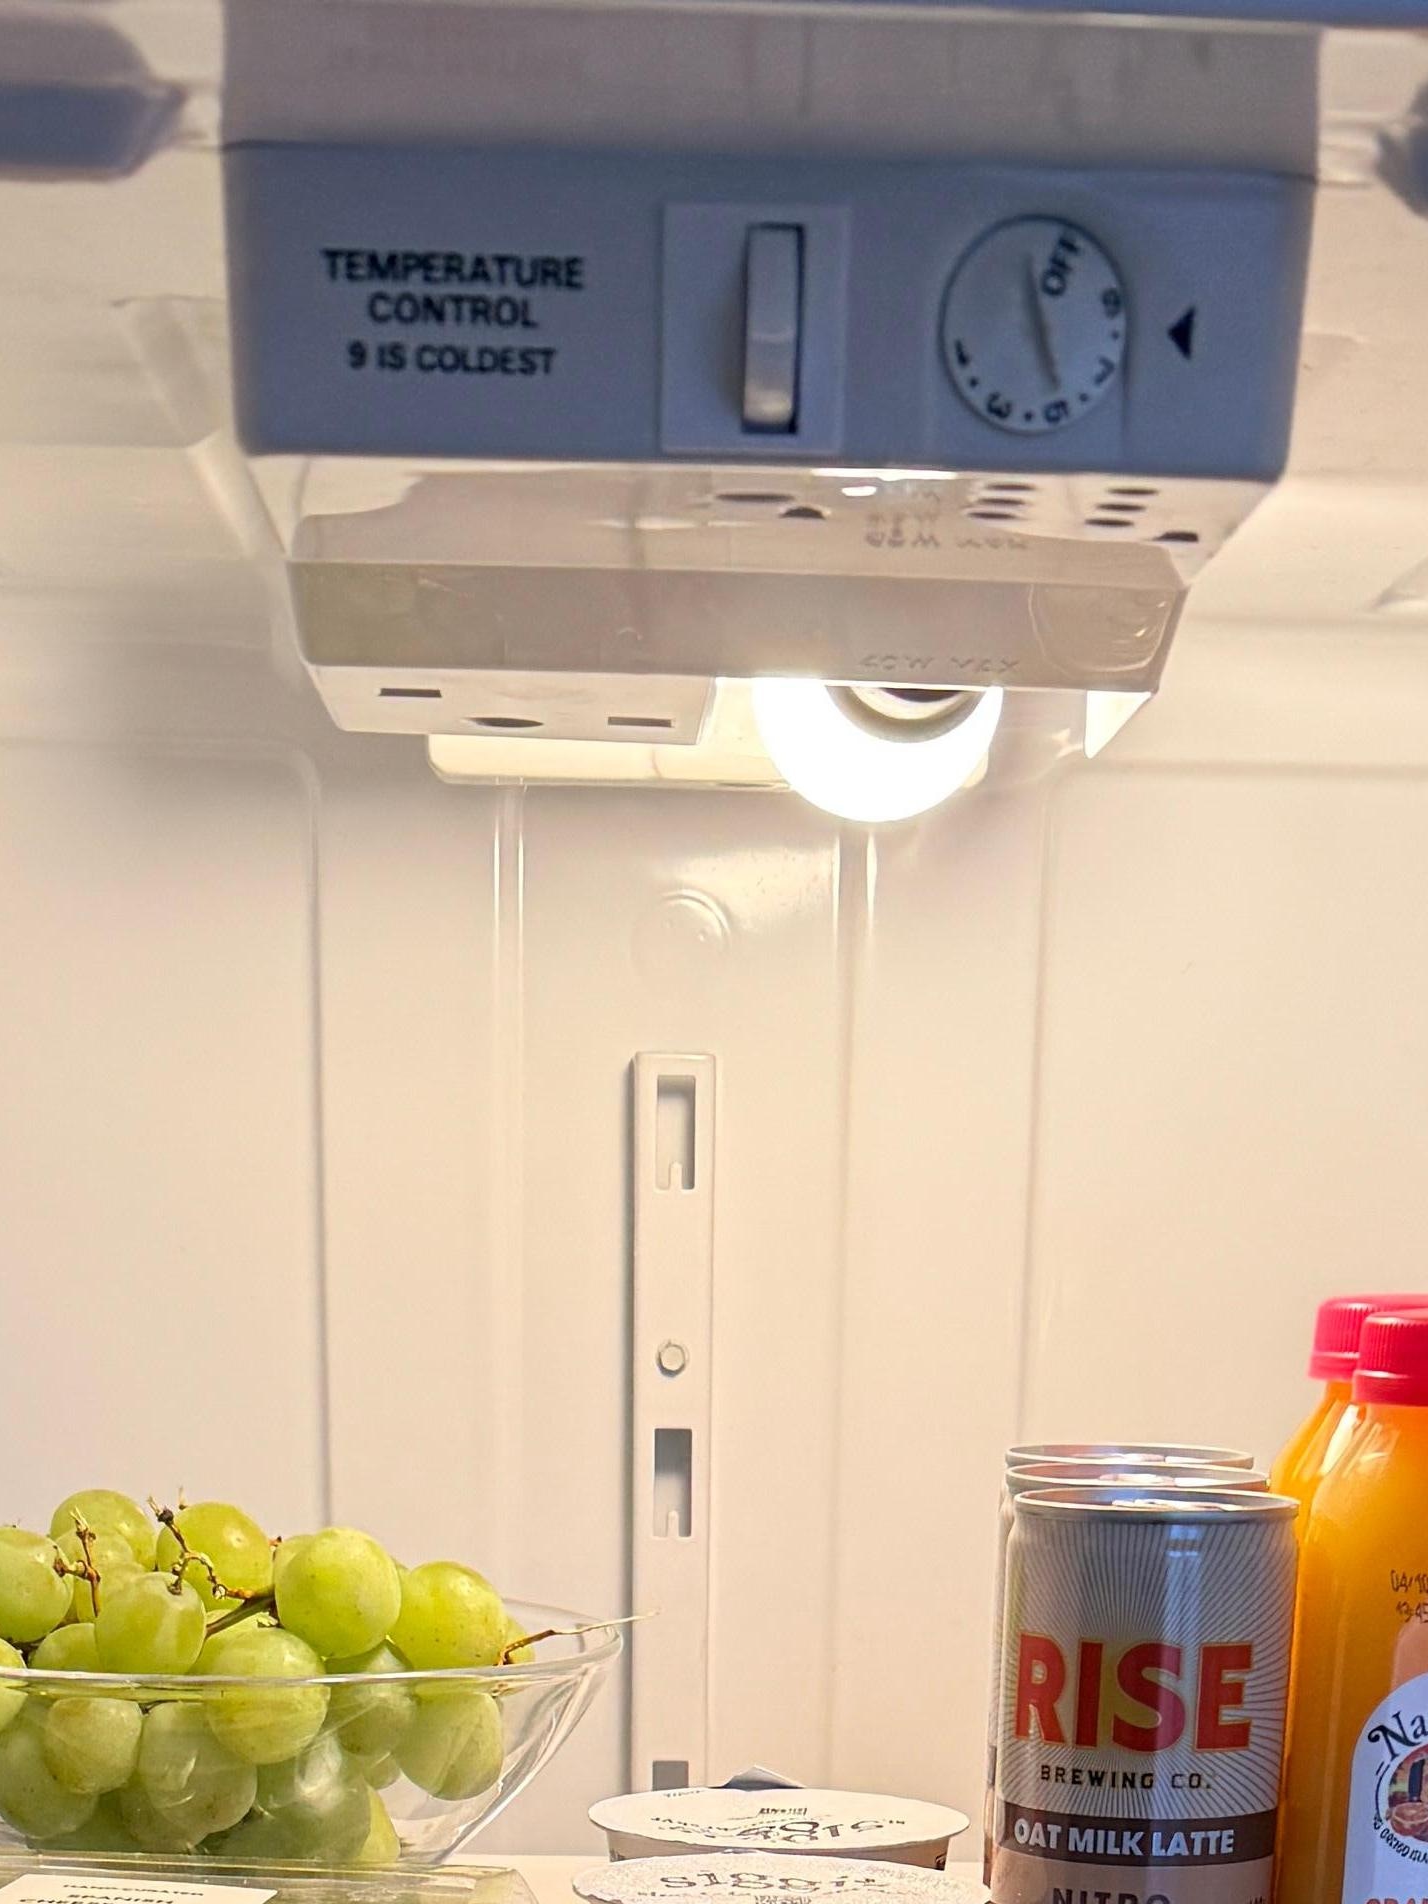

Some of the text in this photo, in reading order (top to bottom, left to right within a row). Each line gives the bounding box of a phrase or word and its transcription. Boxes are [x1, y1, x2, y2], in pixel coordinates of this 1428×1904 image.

[321, 247, 584, 291] TEMPERATURE
[1041, 234, 1080, 297] OFF
[368, 291, 538, 329] CONTROL
[348, 339, 557, 375] 9 IS COLDEST
[1014, 1631, 1254, 1754] RISE
[1040, 1764, 1154, 1789] BREWING
[1014, 1819, 1235, 1856] OAT MILK LATTE
